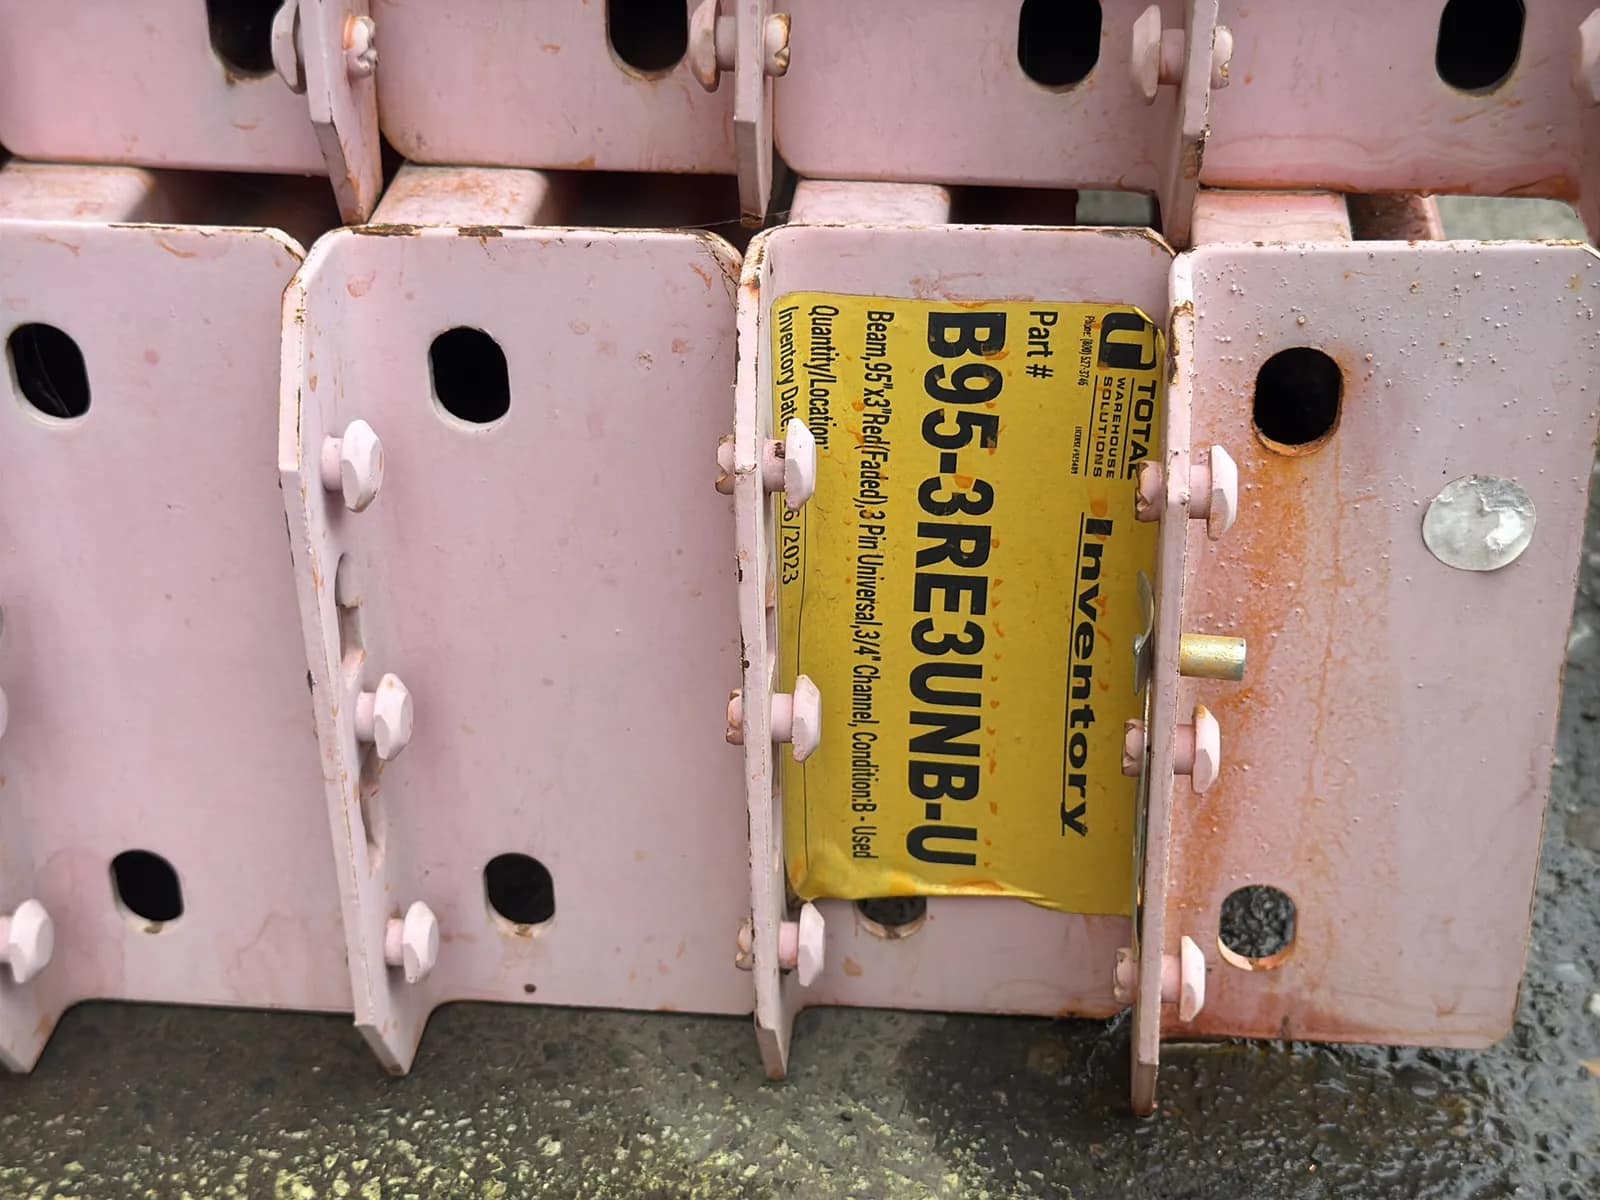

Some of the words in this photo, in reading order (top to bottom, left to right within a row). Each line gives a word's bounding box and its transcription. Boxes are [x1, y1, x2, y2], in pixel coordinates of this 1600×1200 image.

[776, 305, 800, 386] Inventory
[1025, 363, 1054, 379] #
[1026, 311, 1058, 357] Part
[1093, 376, 1113, 478] SOLUTIONS
[1105, 377, 1126, 479] WAREHOUSE
[858, 524, 887, 550] Pin
[906, 311, 1007, 866] B95-3RE3UNB-U
[847, 664, 881, 727] Channel,
[1060, 518, 1113, 837] Inventory
[851, 731, 878, 812] Condition:B
[852, 826, 879, 859] Used
